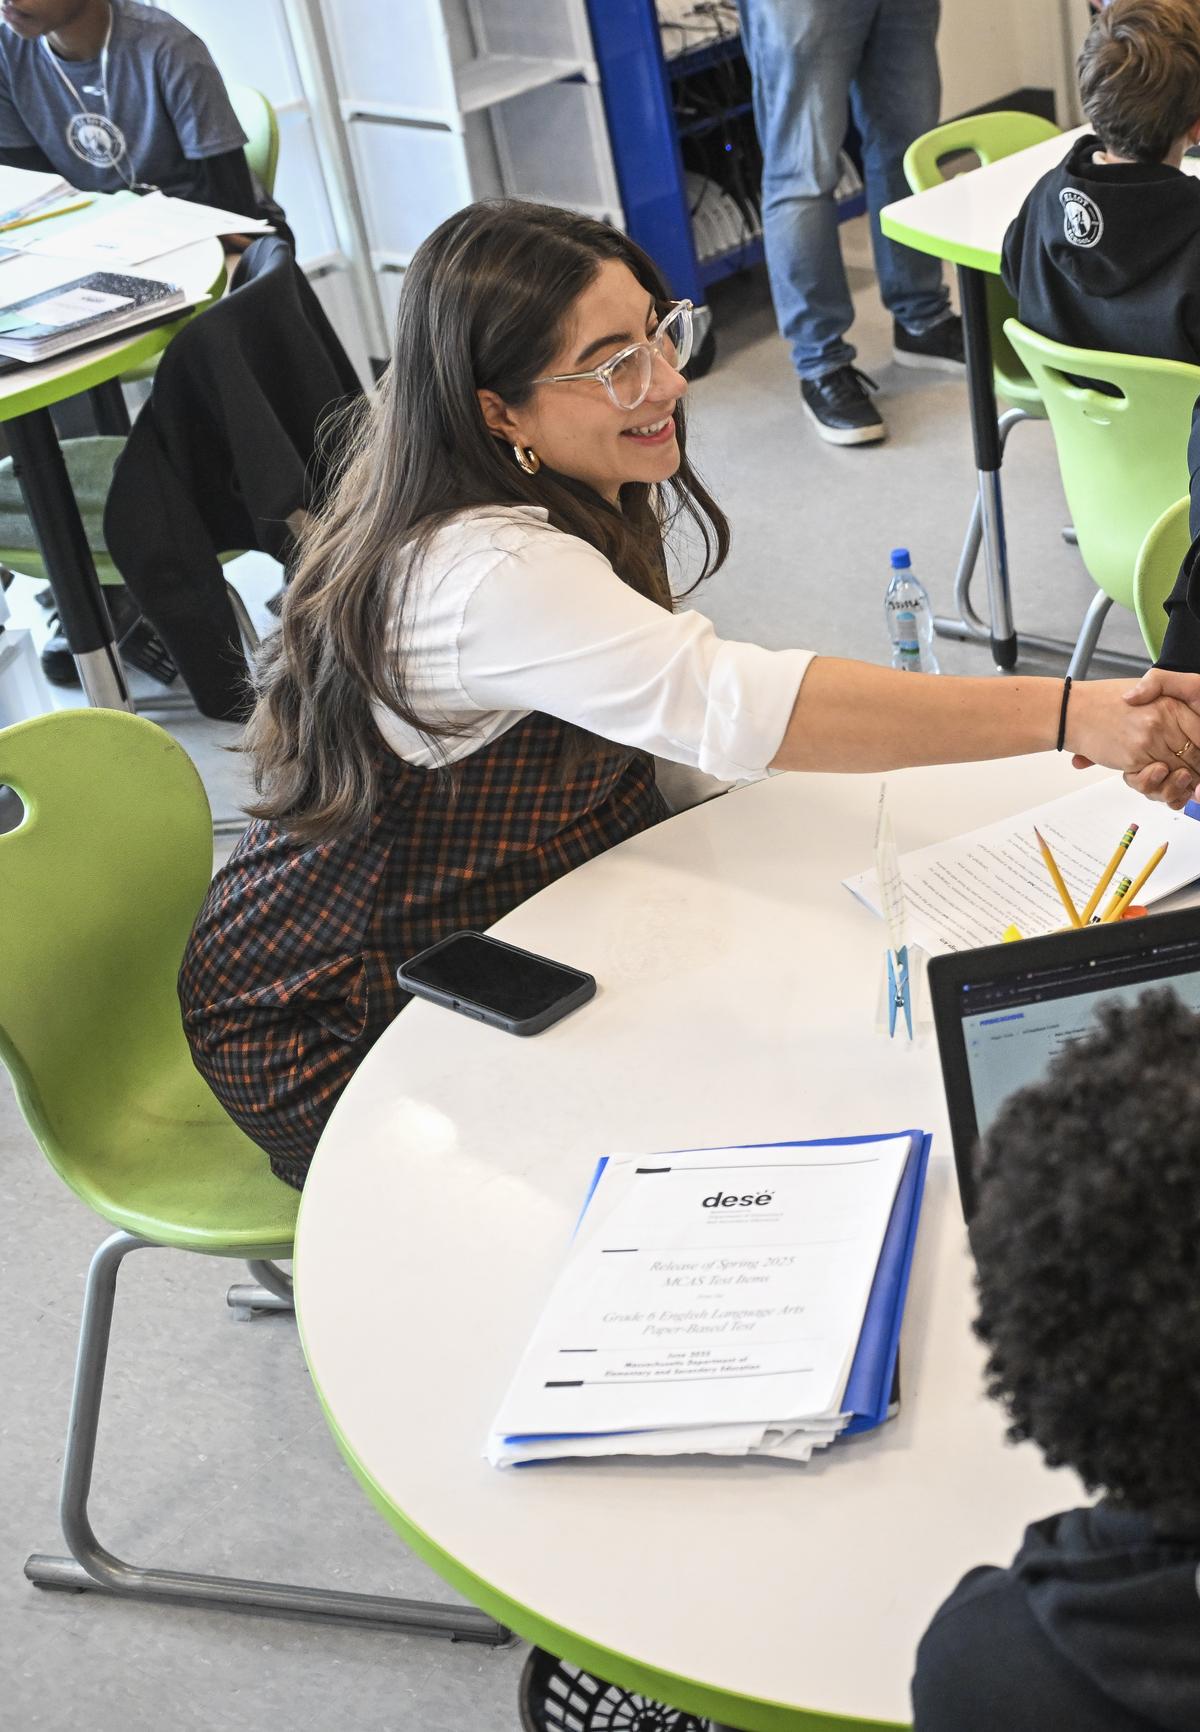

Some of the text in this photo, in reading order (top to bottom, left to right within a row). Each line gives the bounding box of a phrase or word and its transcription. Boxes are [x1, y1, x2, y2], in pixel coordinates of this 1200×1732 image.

[650, 1260, 699, 1272] Release
[700, 1259, 715, 1271] of
[717, 1258, 759, 1271] Spring
[663, 1273, 770, 1287] MCAS Test Items
[602, 1312, 644, 1323] Grade
[658, 1309, 708, 1323] English
[711, 1306, 777, 1321] Language
[778, 1304, 805, 1316] Arts
[642, 1321, 756, 1337] Paper-Based Test
